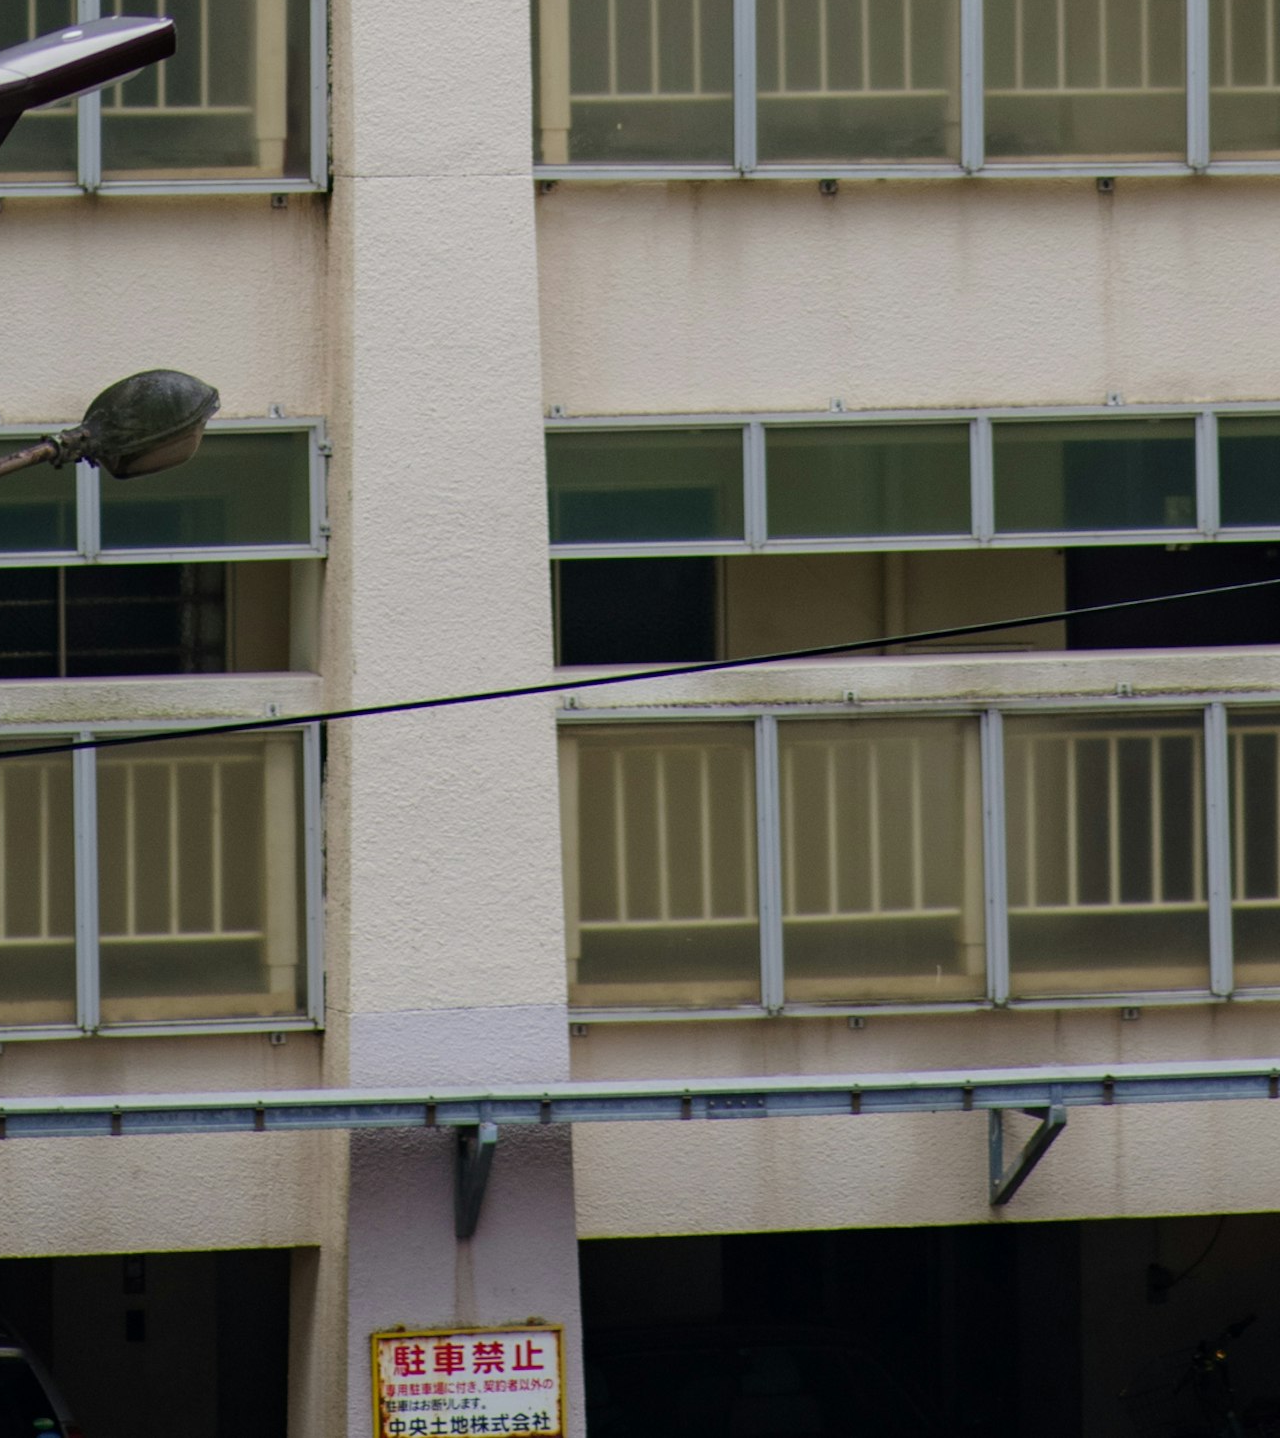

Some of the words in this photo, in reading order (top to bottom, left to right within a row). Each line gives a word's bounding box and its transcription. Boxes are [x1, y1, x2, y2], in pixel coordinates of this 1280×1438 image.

[393, 1340, 544, 1377] 駐車禁止
[388, 1411, 552, 1437] 中央土地株式会社
